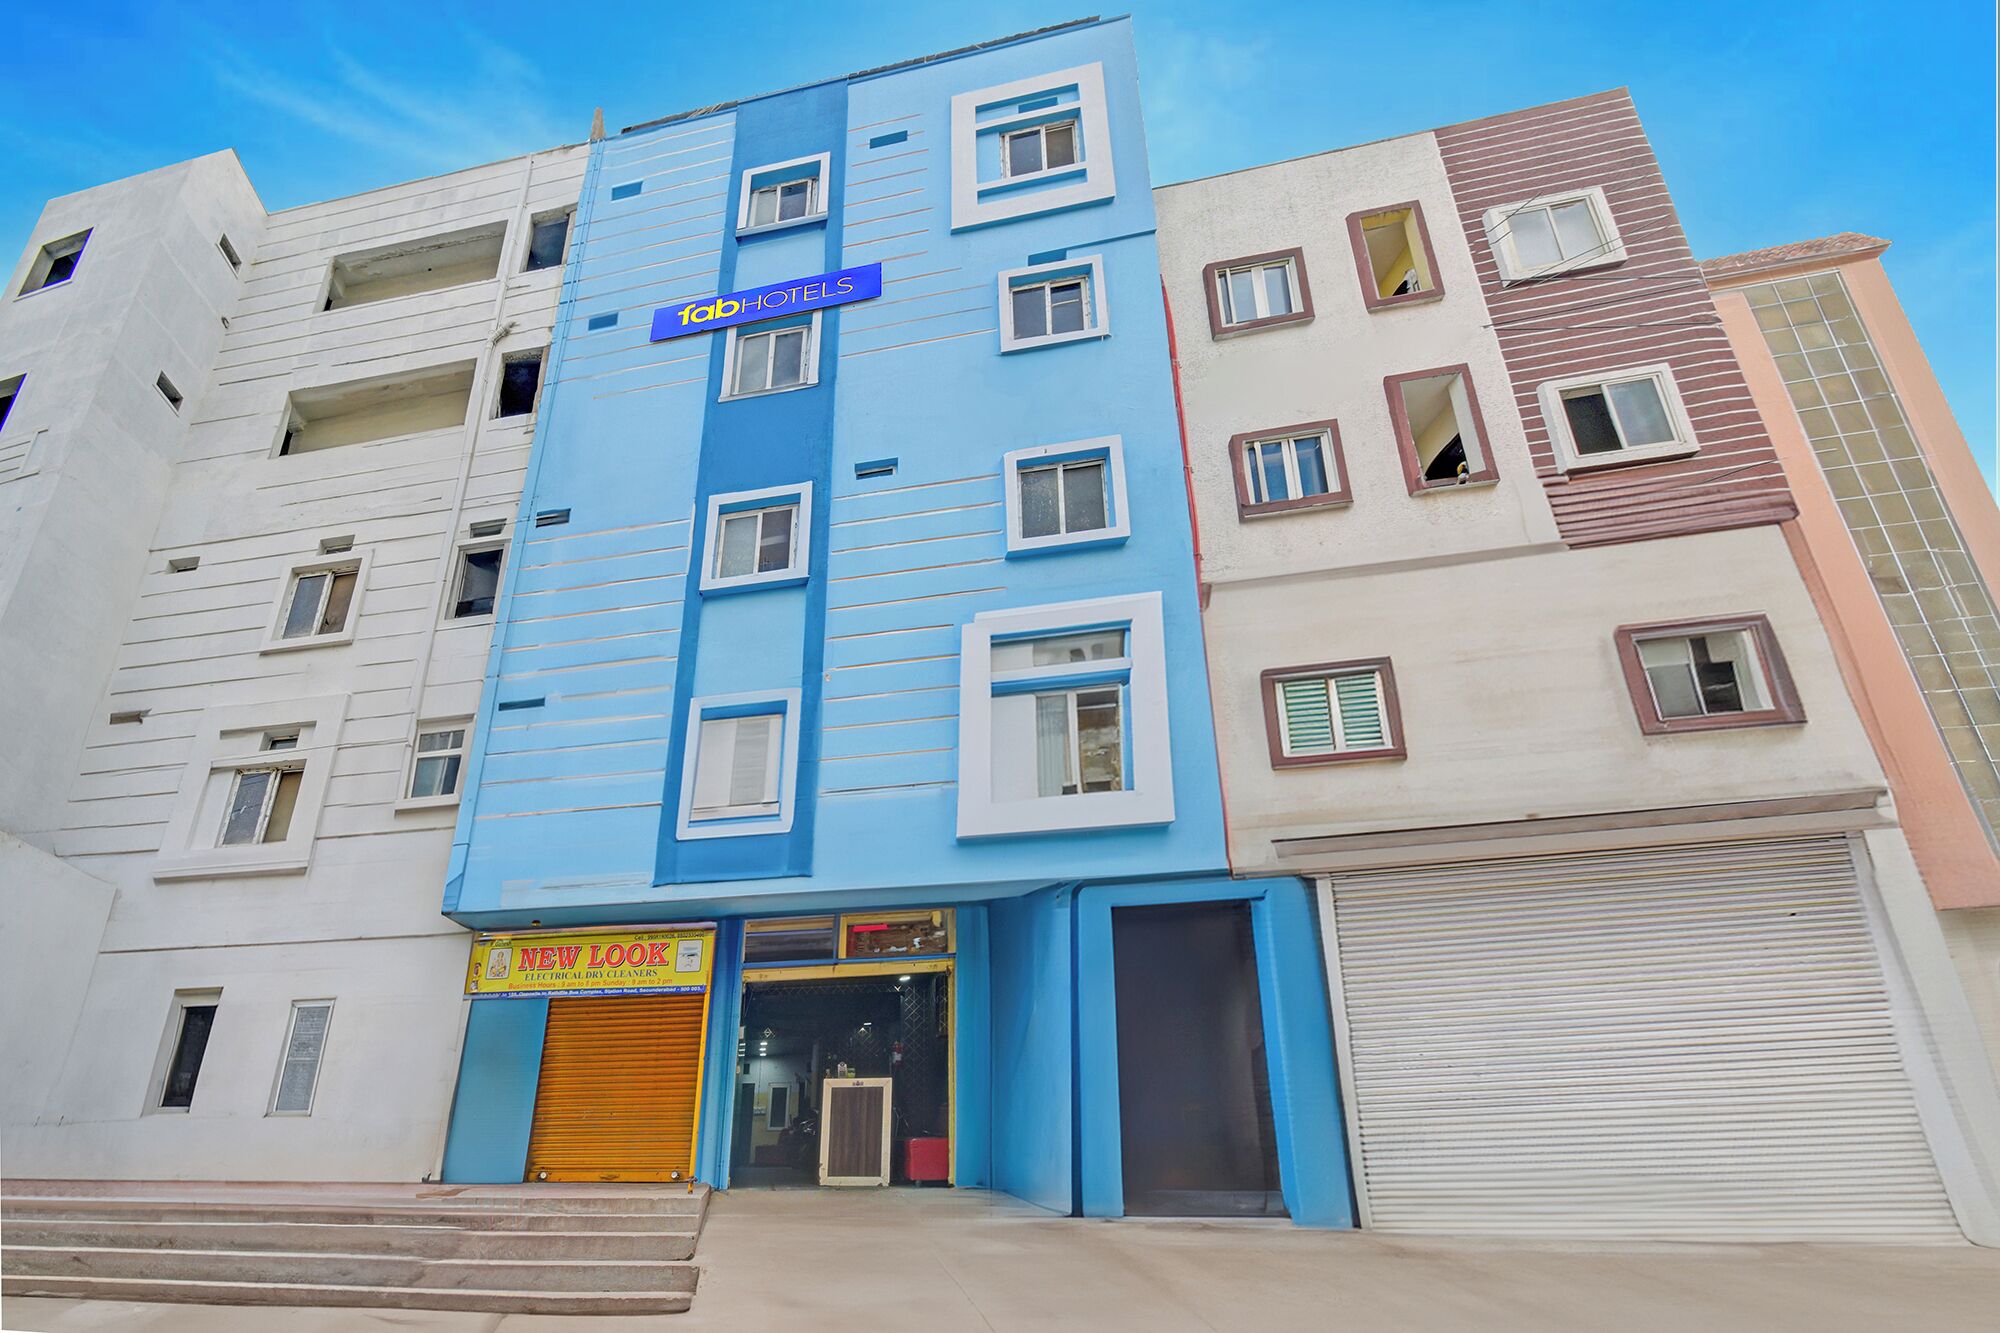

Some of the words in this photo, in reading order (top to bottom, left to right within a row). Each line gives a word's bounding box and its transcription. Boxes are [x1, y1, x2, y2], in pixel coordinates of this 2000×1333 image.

[518, 945, 582, 971] NEW
[587, 942, 670, 968] LOOK
[524, 971, 583, 981] ELECTRICAL
[585, 970, 604, 979] DRY
[606, 968, 658, 979] CLEANERS
[508, 982, 536, 990] Business
[538, 981, 556, 989] Hours
[590, 980, 601, 988] pm
[603, 979, 626, 987] Sunday
[662, 978, 673, 986] pm
